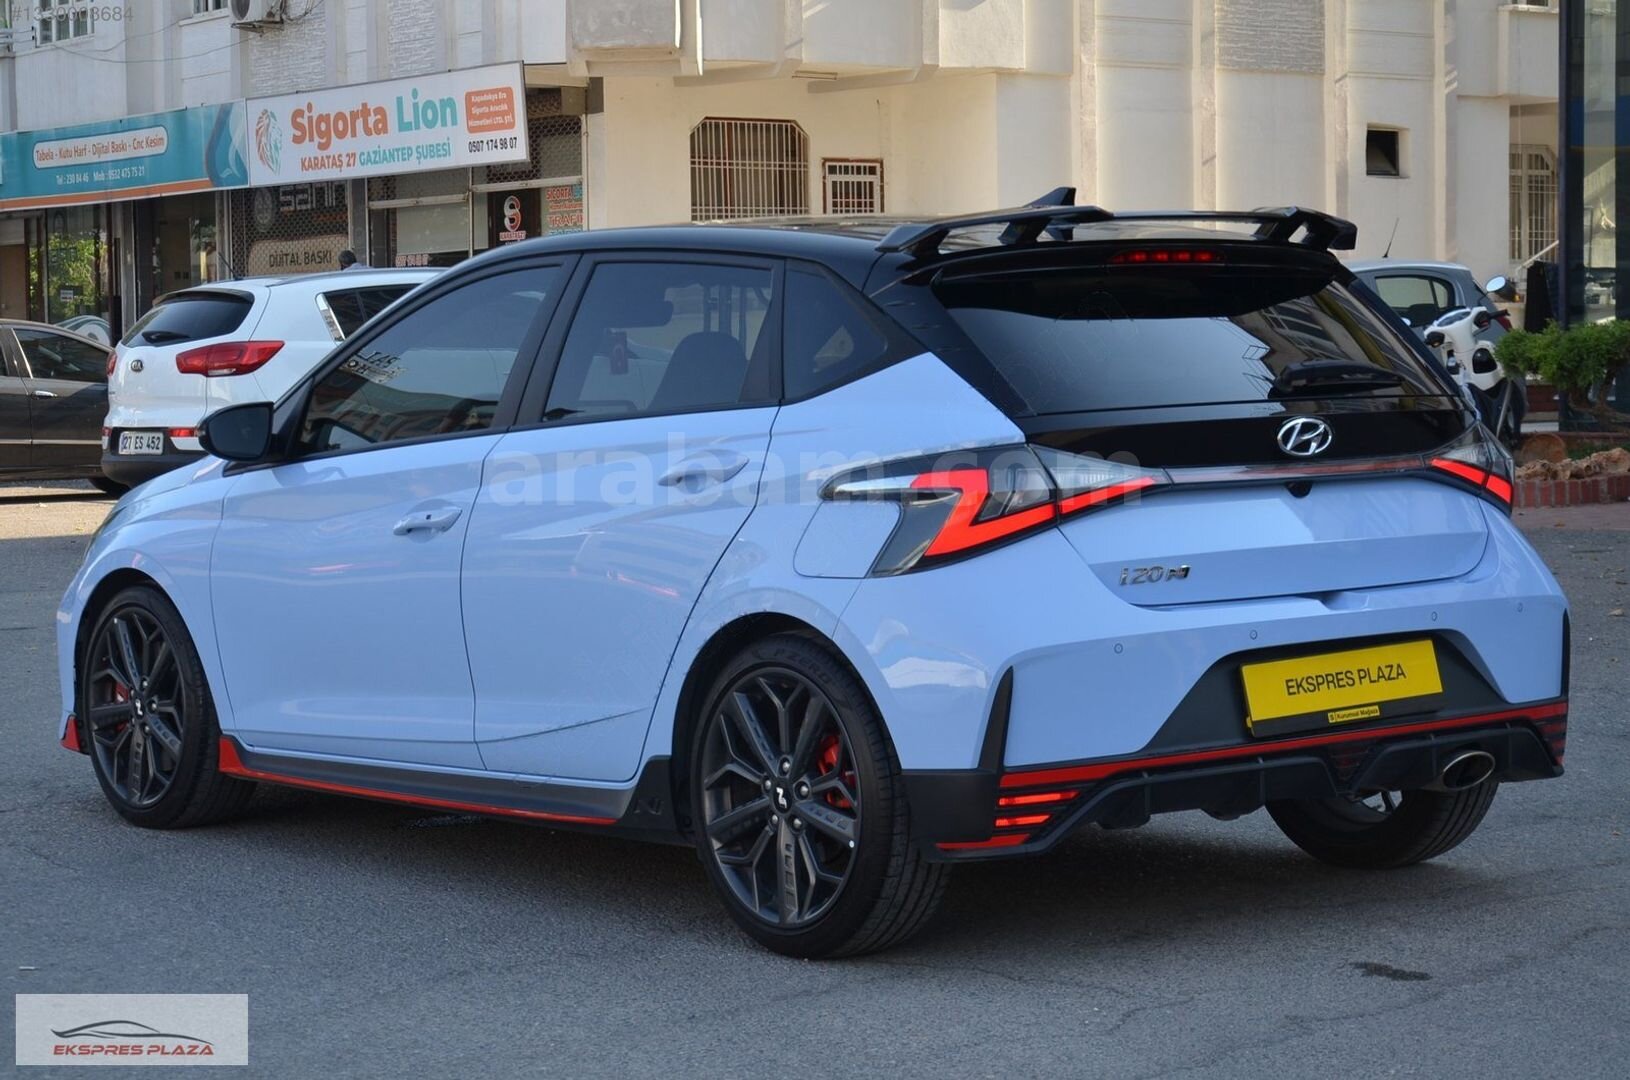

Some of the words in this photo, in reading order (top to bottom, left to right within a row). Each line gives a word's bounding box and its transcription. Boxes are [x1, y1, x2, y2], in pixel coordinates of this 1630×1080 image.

[291, 102, 388, 151] Sigorta
[396, 88, 458, 133] Lion
[36, 149, 54, 162] Tabela
[59, 148, 72, 159] Kutu
[74, 144, 87, 158] Harf
[92, 142, 110, 158] Dijital
[111, 141, 128, 154] Baskı
[132, 138, 144, 151] Cnc
[145, 134, 165, 149] Kesim
[301, 154, 344, 173] KARATAŞ
[346, 152, 356, 168] 27
[359, 145, 413, 166] GAZİANTEP
[415, 137, 451, 165] ŞUBESİ
[468, 140, 484, 153] 0507
[486, 138, 498, 151] 174
[499, 138, 508, 150] 98
[509, 137, 517, 149] 07
[123, 436, 132, 450] 27
[134, 436, 143, 450] ES
[146, 436, 161, 450] 452
[1119, 566, 1165, 586] i20
[1285, 671, 1355, 696] EKSPRES
[1357, 663, 1407, 685] PLAZA
